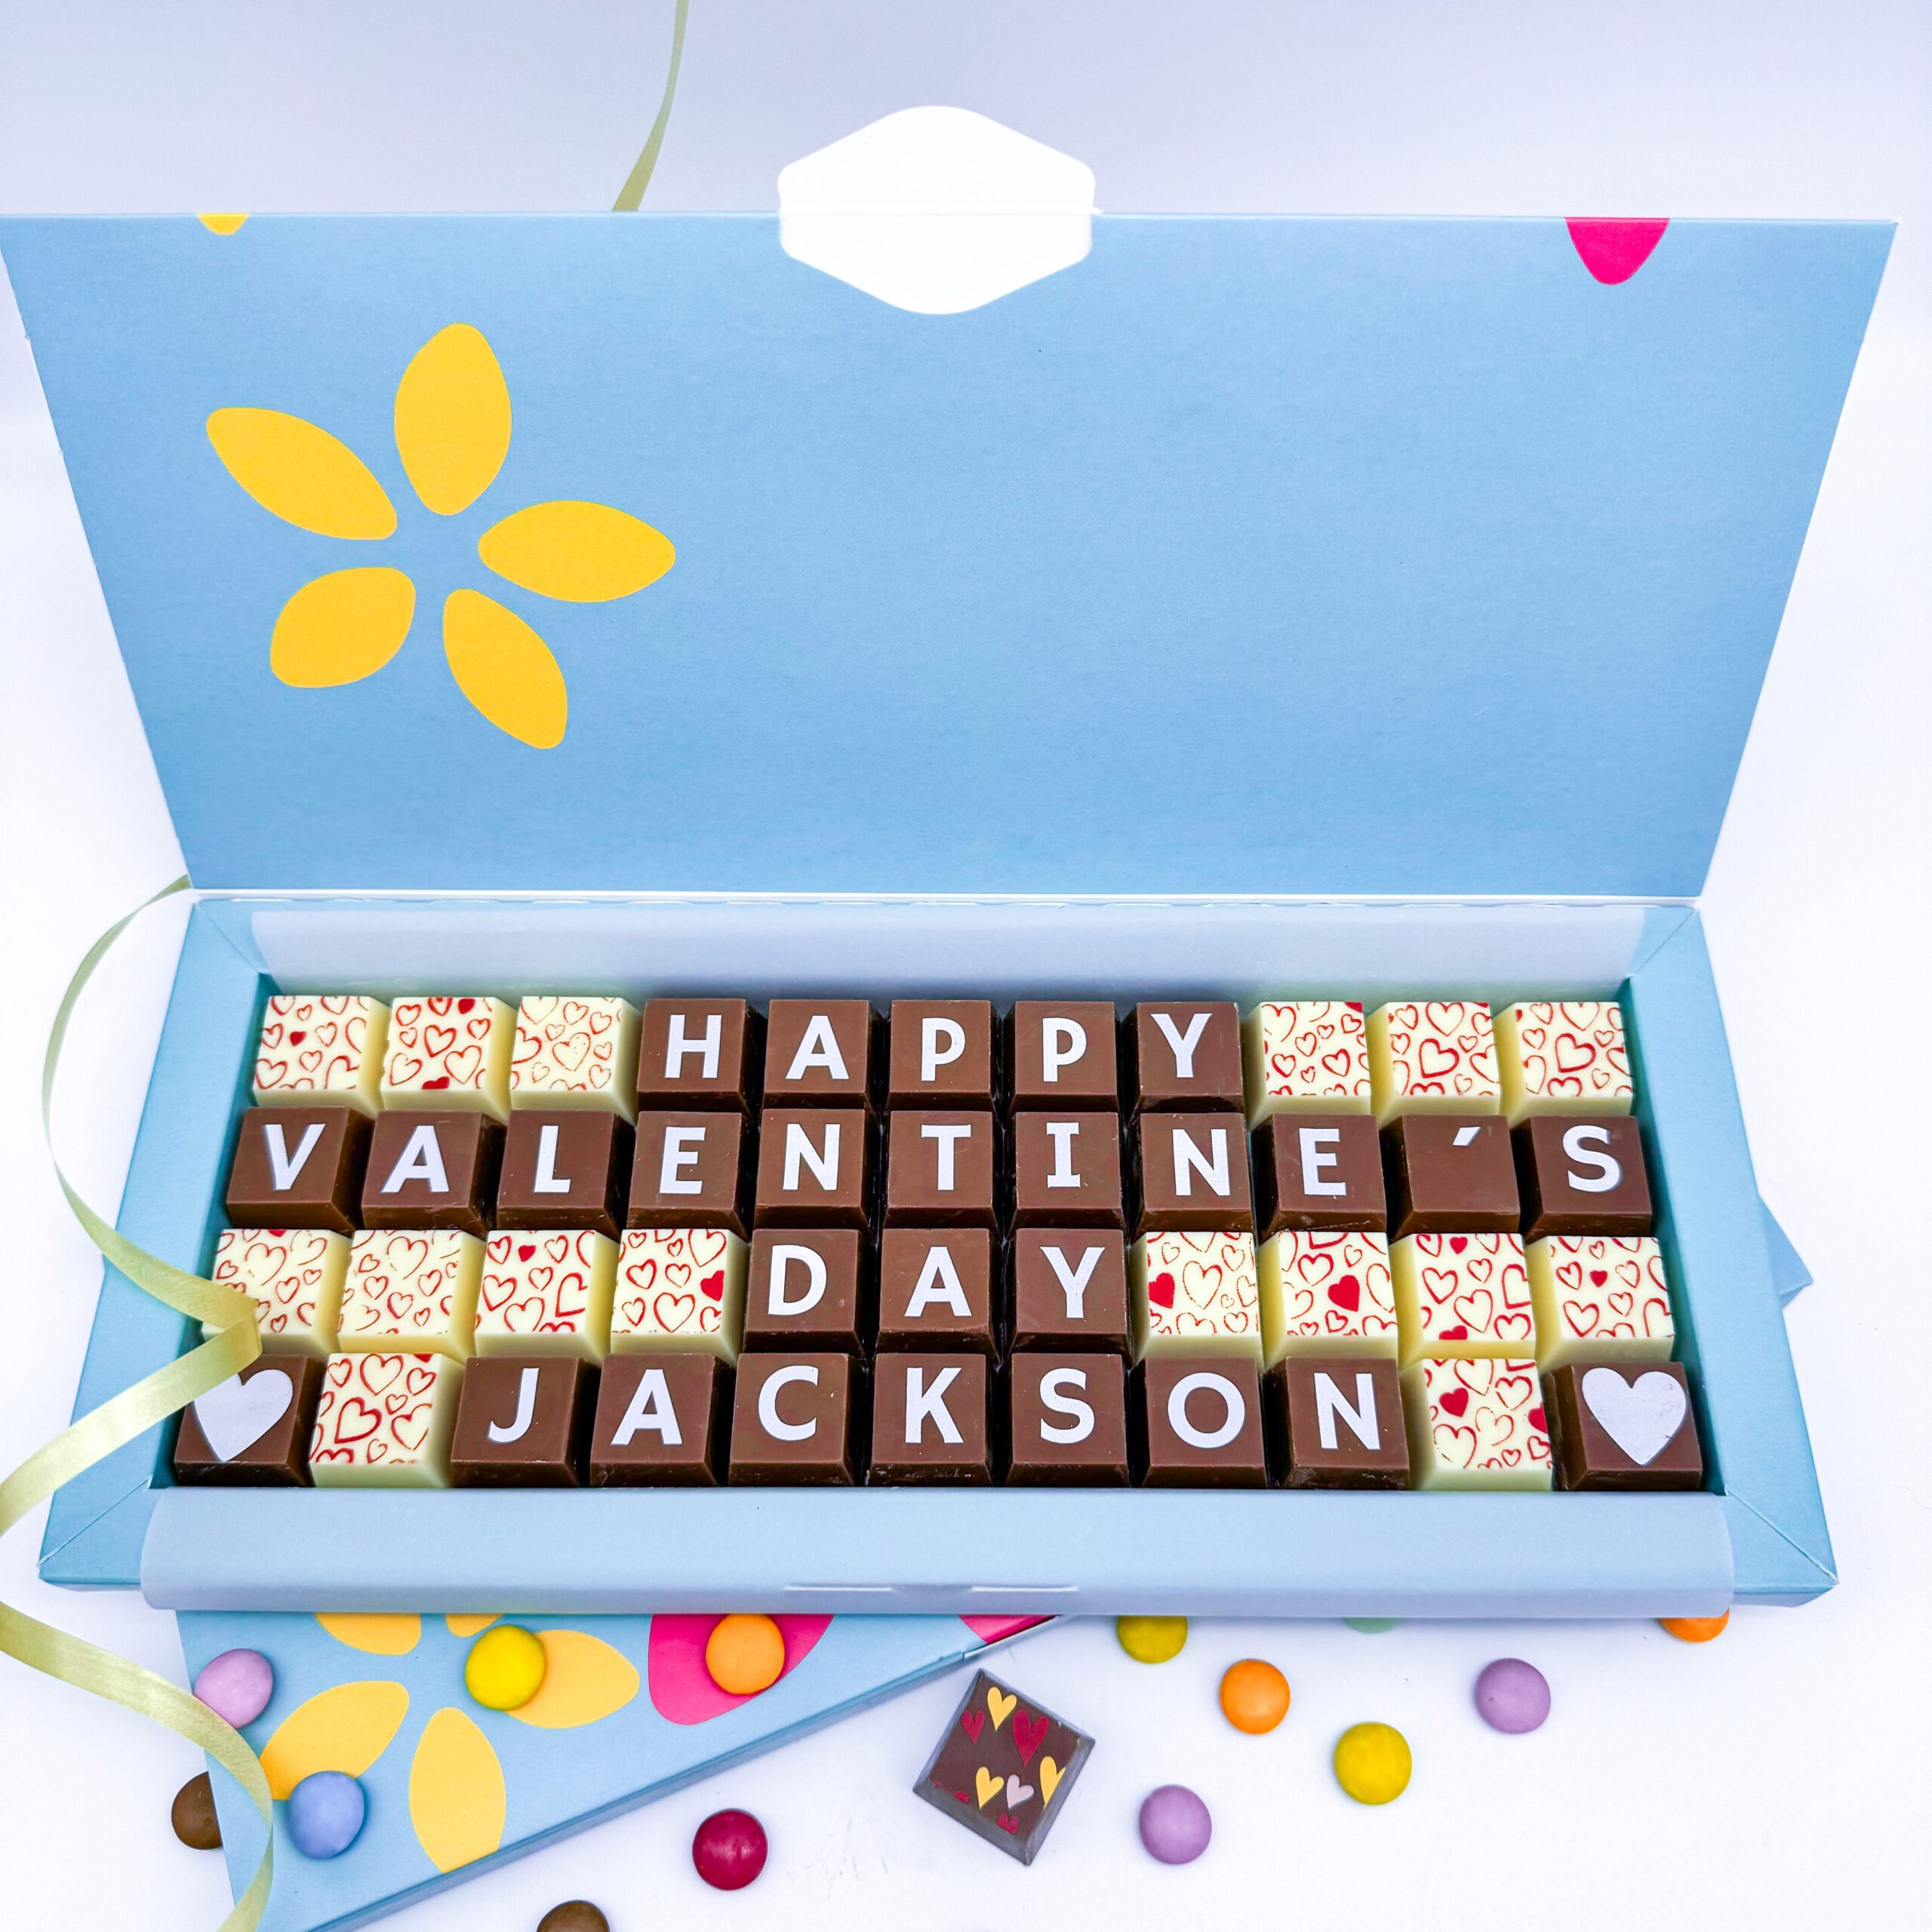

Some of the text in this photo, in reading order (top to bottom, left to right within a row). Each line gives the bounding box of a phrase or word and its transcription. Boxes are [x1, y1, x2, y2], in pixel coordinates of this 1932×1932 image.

[664, 1013, 1213, 1083] HAPPY
[768, 1244, 1106, 1318] DAY
[488, 1365, 1381, 1451] JACKSON
